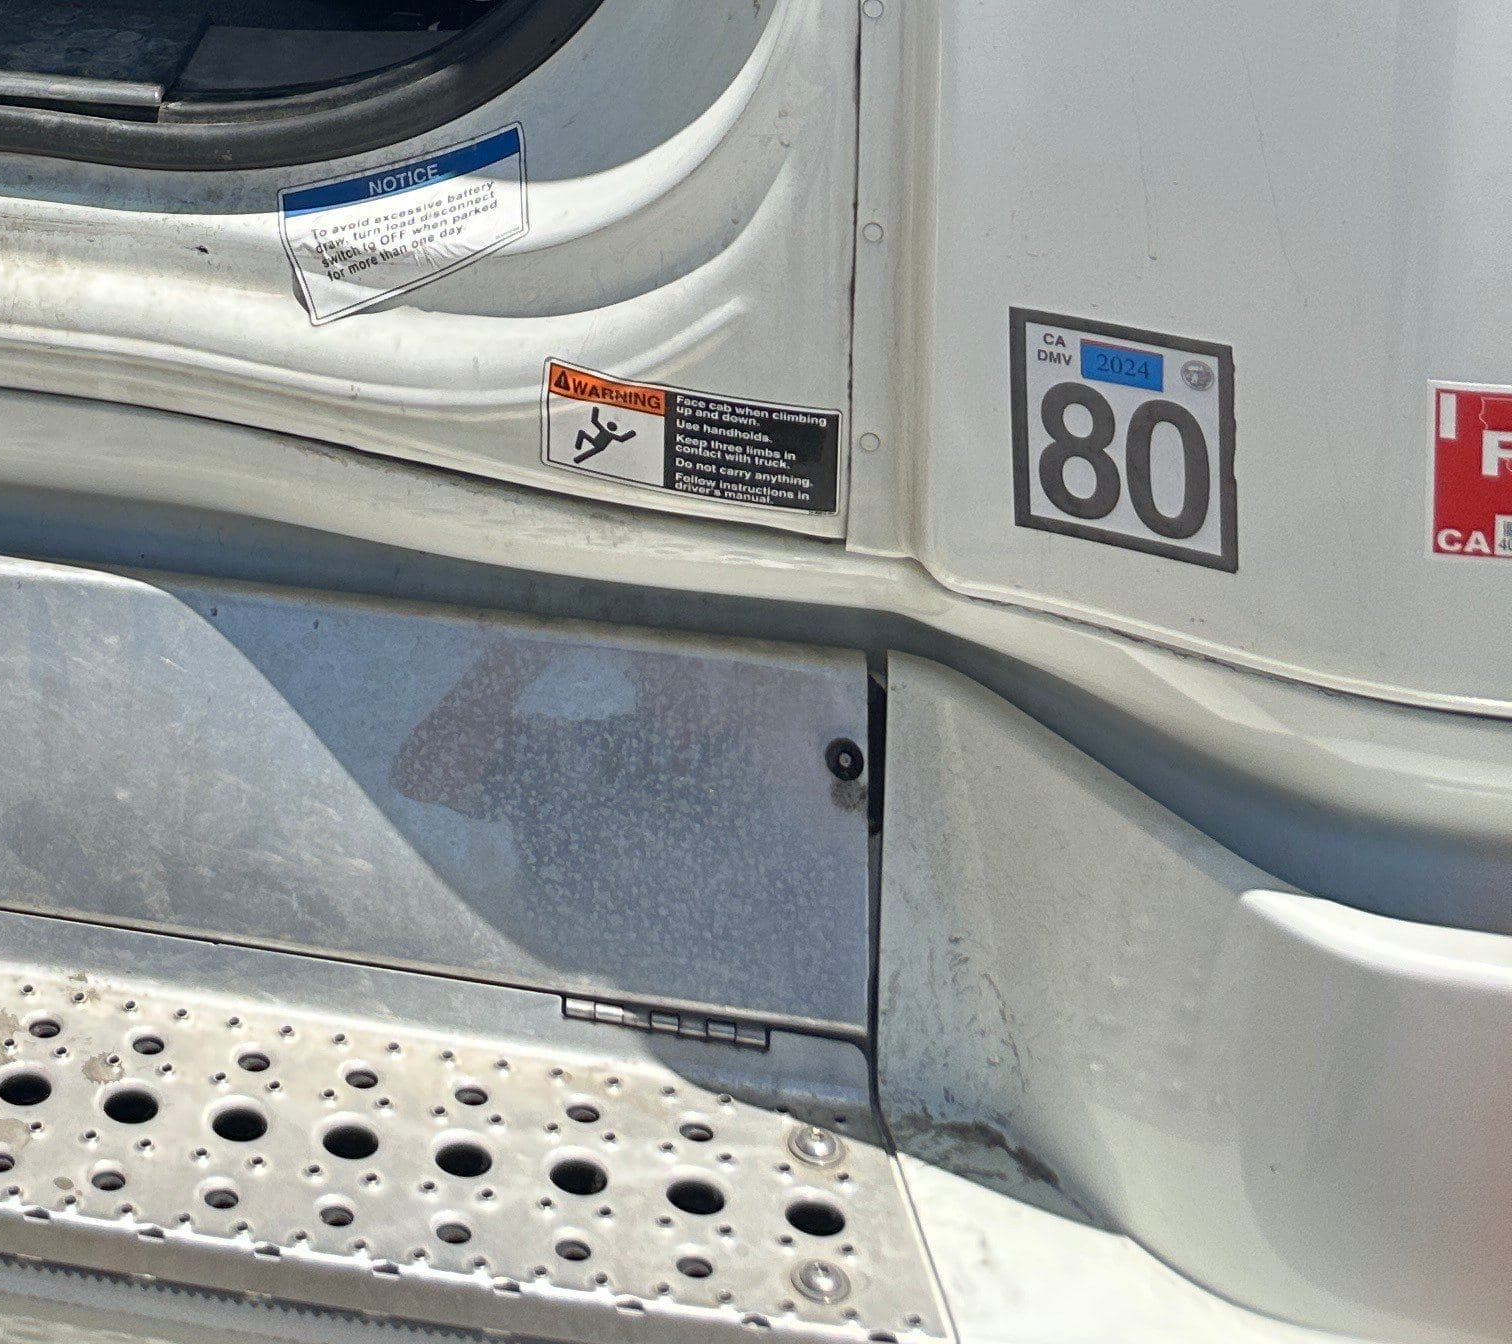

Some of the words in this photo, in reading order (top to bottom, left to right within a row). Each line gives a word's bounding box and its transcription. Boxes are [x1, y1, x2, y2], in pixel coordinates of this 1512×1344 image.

[368, 164, 439, 196] NOTICE
[312, 229, 327, 240] To
[333, 219, 369, 234] avoid
[375, 199, 442, 223] excessive
[447, 181, 494, 204] battery
[353, 227, 381, 241] turn
[386, 216, 415, 232] load
[420, 191, 496, 223] disconnect
[321, 247, 361, 268] switch
[380, 230, 407, 247] OFF
[412, 220, 448, 234] when
[453, 200, 498, 224] parked
[327, 268, 346, 282] for
[348, 256, 379, 276] more
[381, 245, 407, 262] than
[411, 234, 434, 251] one
[1042, 332, 1066, 348] CA
[1037, 348, 1073, 367] DMV
[1096, 353, 1149, 380] 2024
[572, 377, 661, 410] WARNING
[676, 396, 706, 408] Face
[709, 402, 731, 412] cab
[735, 406, 769, 418] when
[773, 412, 827, 427] climbing
[676, 419, 700, 431] Use
[677, 405, 692, 416] up
[695, 408, 718, 419] and
[675, 444, 721, 458] contact
[725, 452, 751, 464] with
[676, 434, 707, 447] Keep
[711, 439, 743, 453] three
[746, 446, 781, 458] limbs
[784, 450, 796, 460] in
[1038, 381, 1212, 540] 80
[675, 457, 692, 468] Do
[696, 462, 716, 473] not
[720, 466, 751, 480] carry
[675, 473, 716, 486] Follow
[720, 480, 794, 499] instructions
[798, 491, 810, 501] in
[1437, 528, 1491, 554] CA
